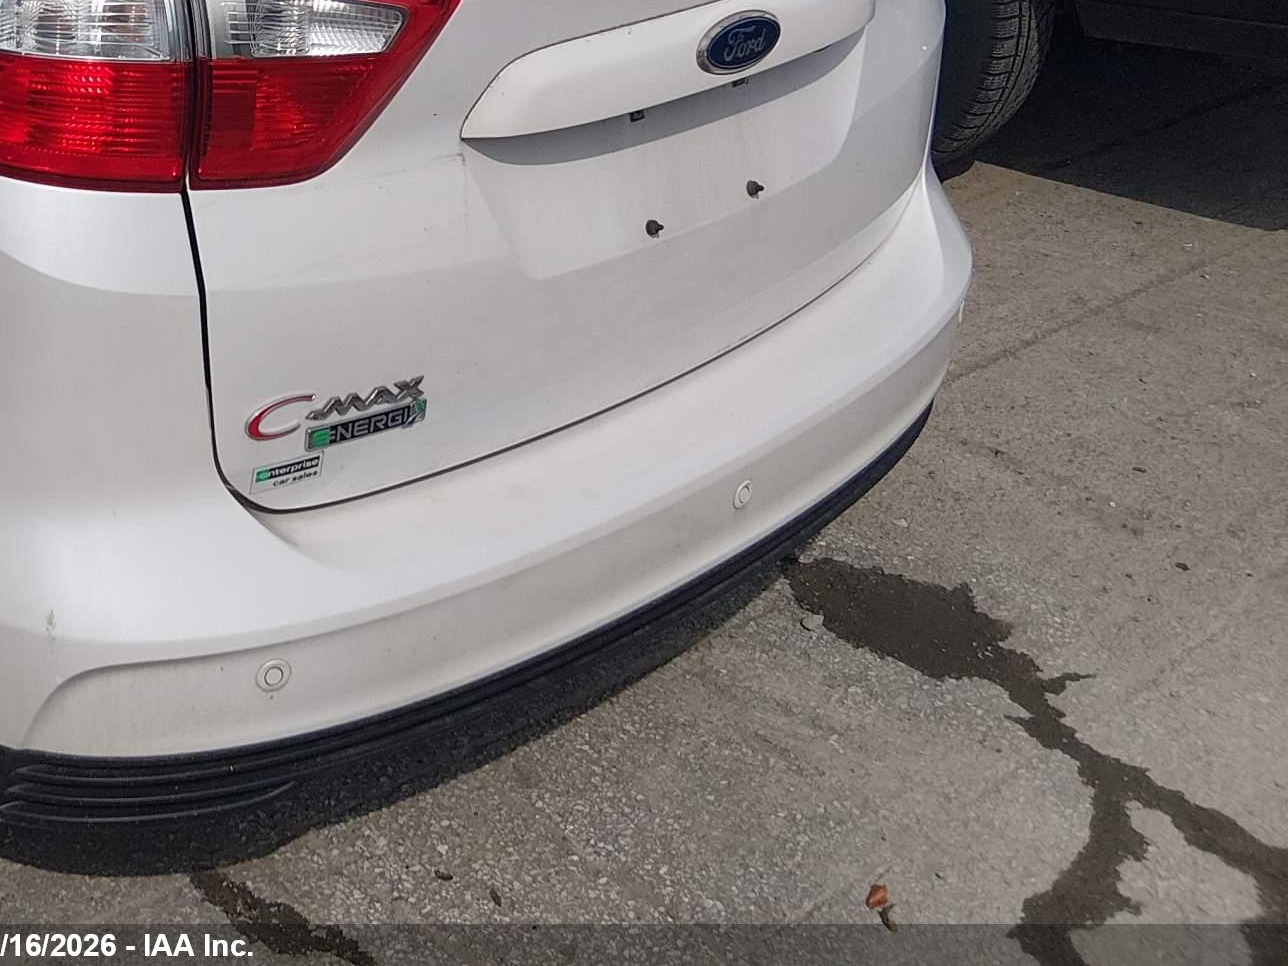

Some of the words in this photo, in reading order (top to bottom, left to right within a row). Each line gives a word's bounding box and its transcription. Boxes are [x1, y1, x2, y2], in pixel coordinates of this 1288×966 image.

[723, 24, 766, 62] Ford
[272, 477, 290, 487] car
[292, 470, 318, 482] sales
